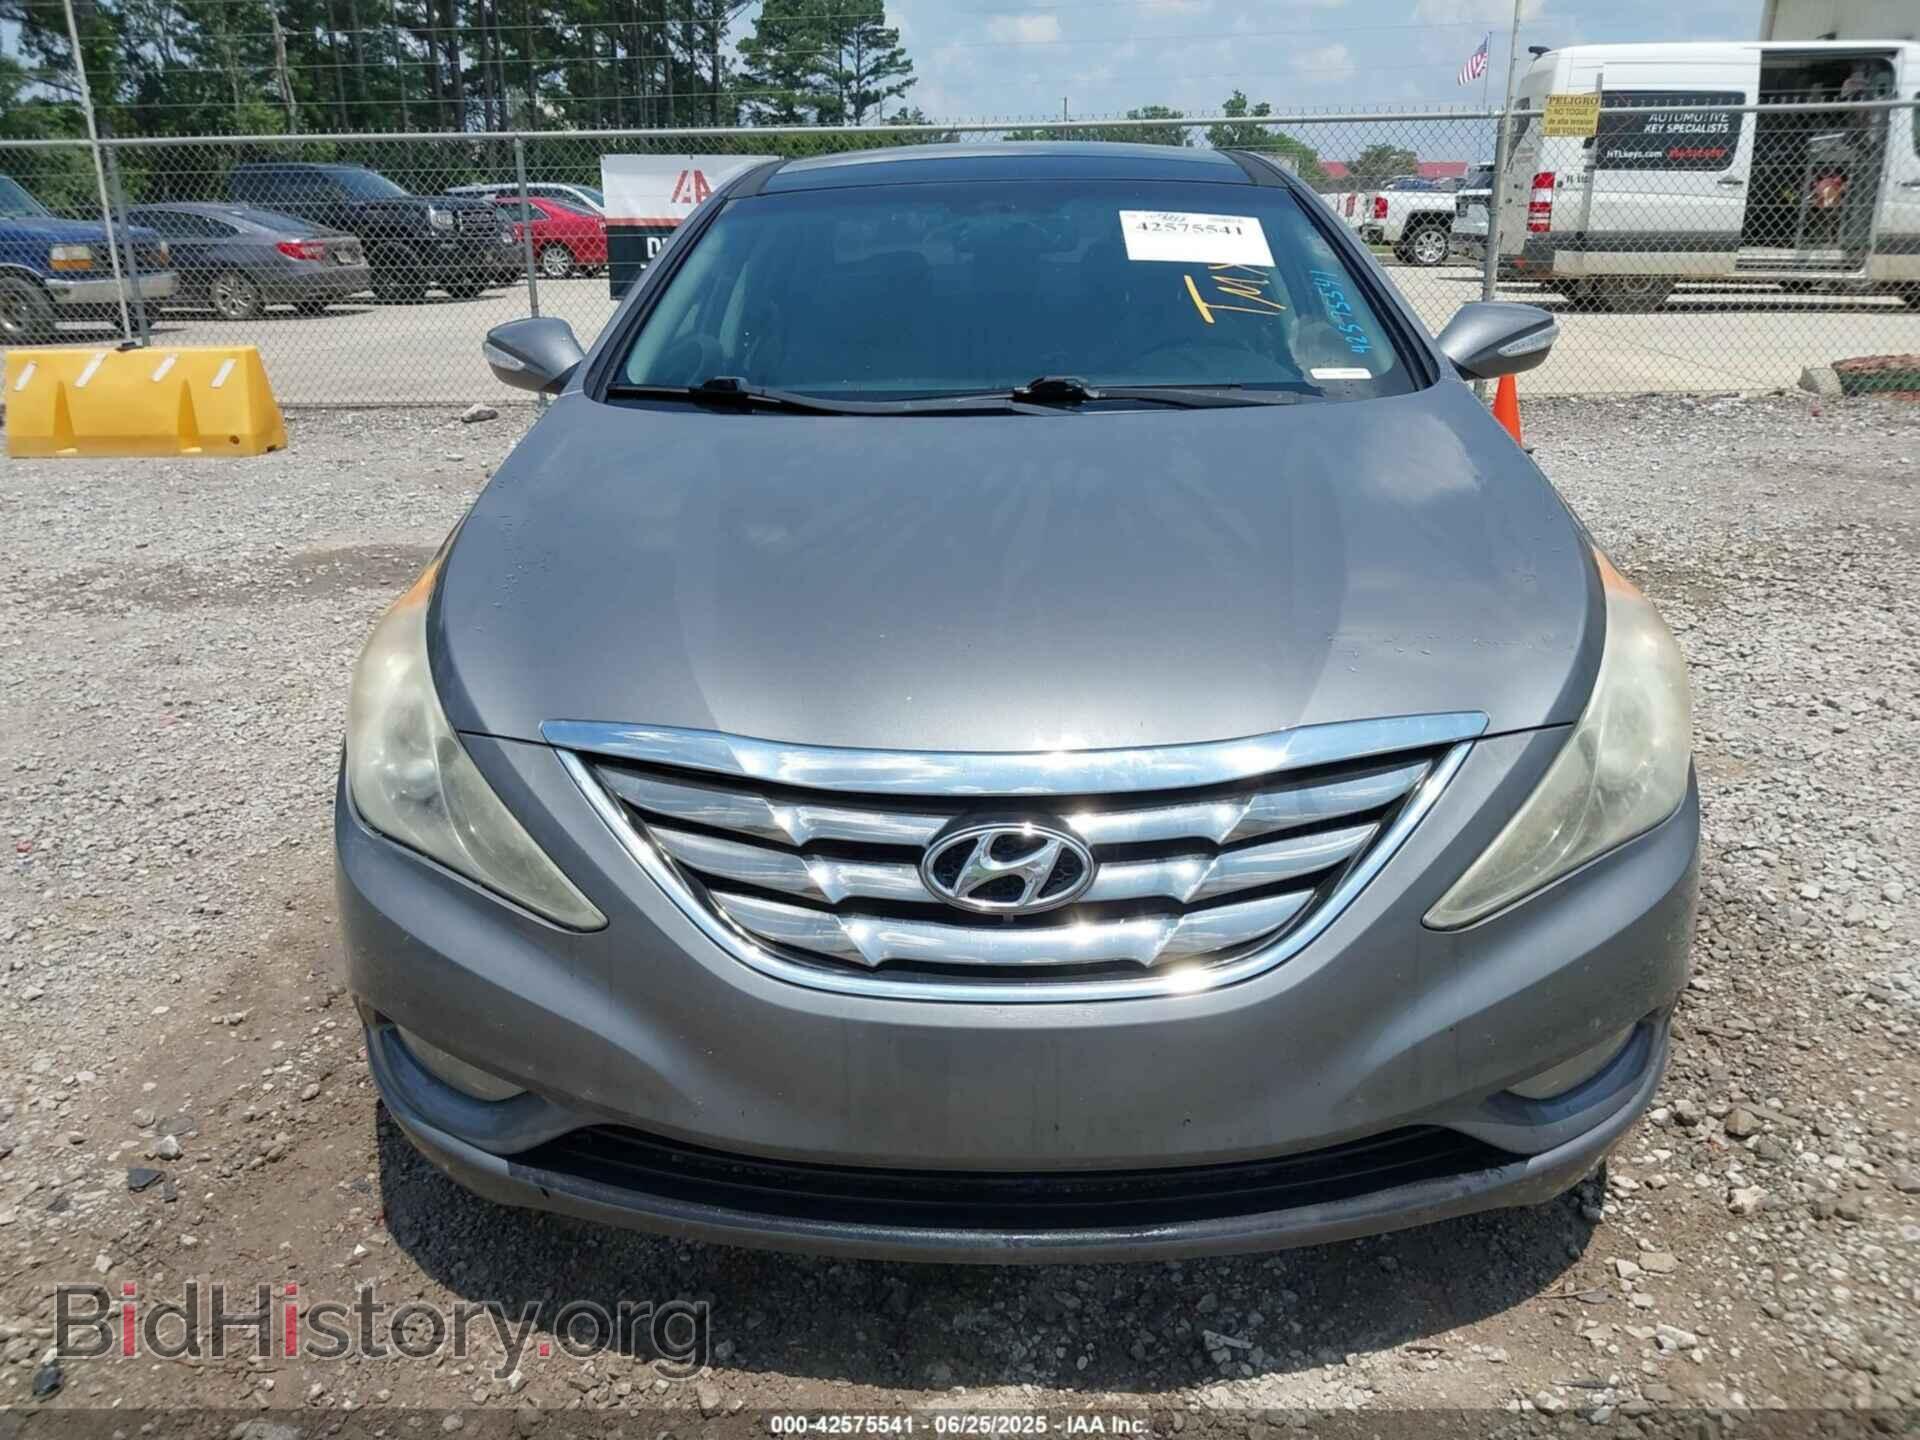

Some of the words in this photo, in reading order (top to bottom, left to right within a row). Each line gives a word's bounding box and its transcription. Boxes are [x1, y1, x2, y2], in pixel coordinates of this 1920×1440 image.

[1548, 95, 1599, 105] PELIGRO
[1643, 124, 1664, 133] KEY
[1666, 123, 1730, 133] SPECIALISTS
[1136, 221, 1243, 236] 42575541
